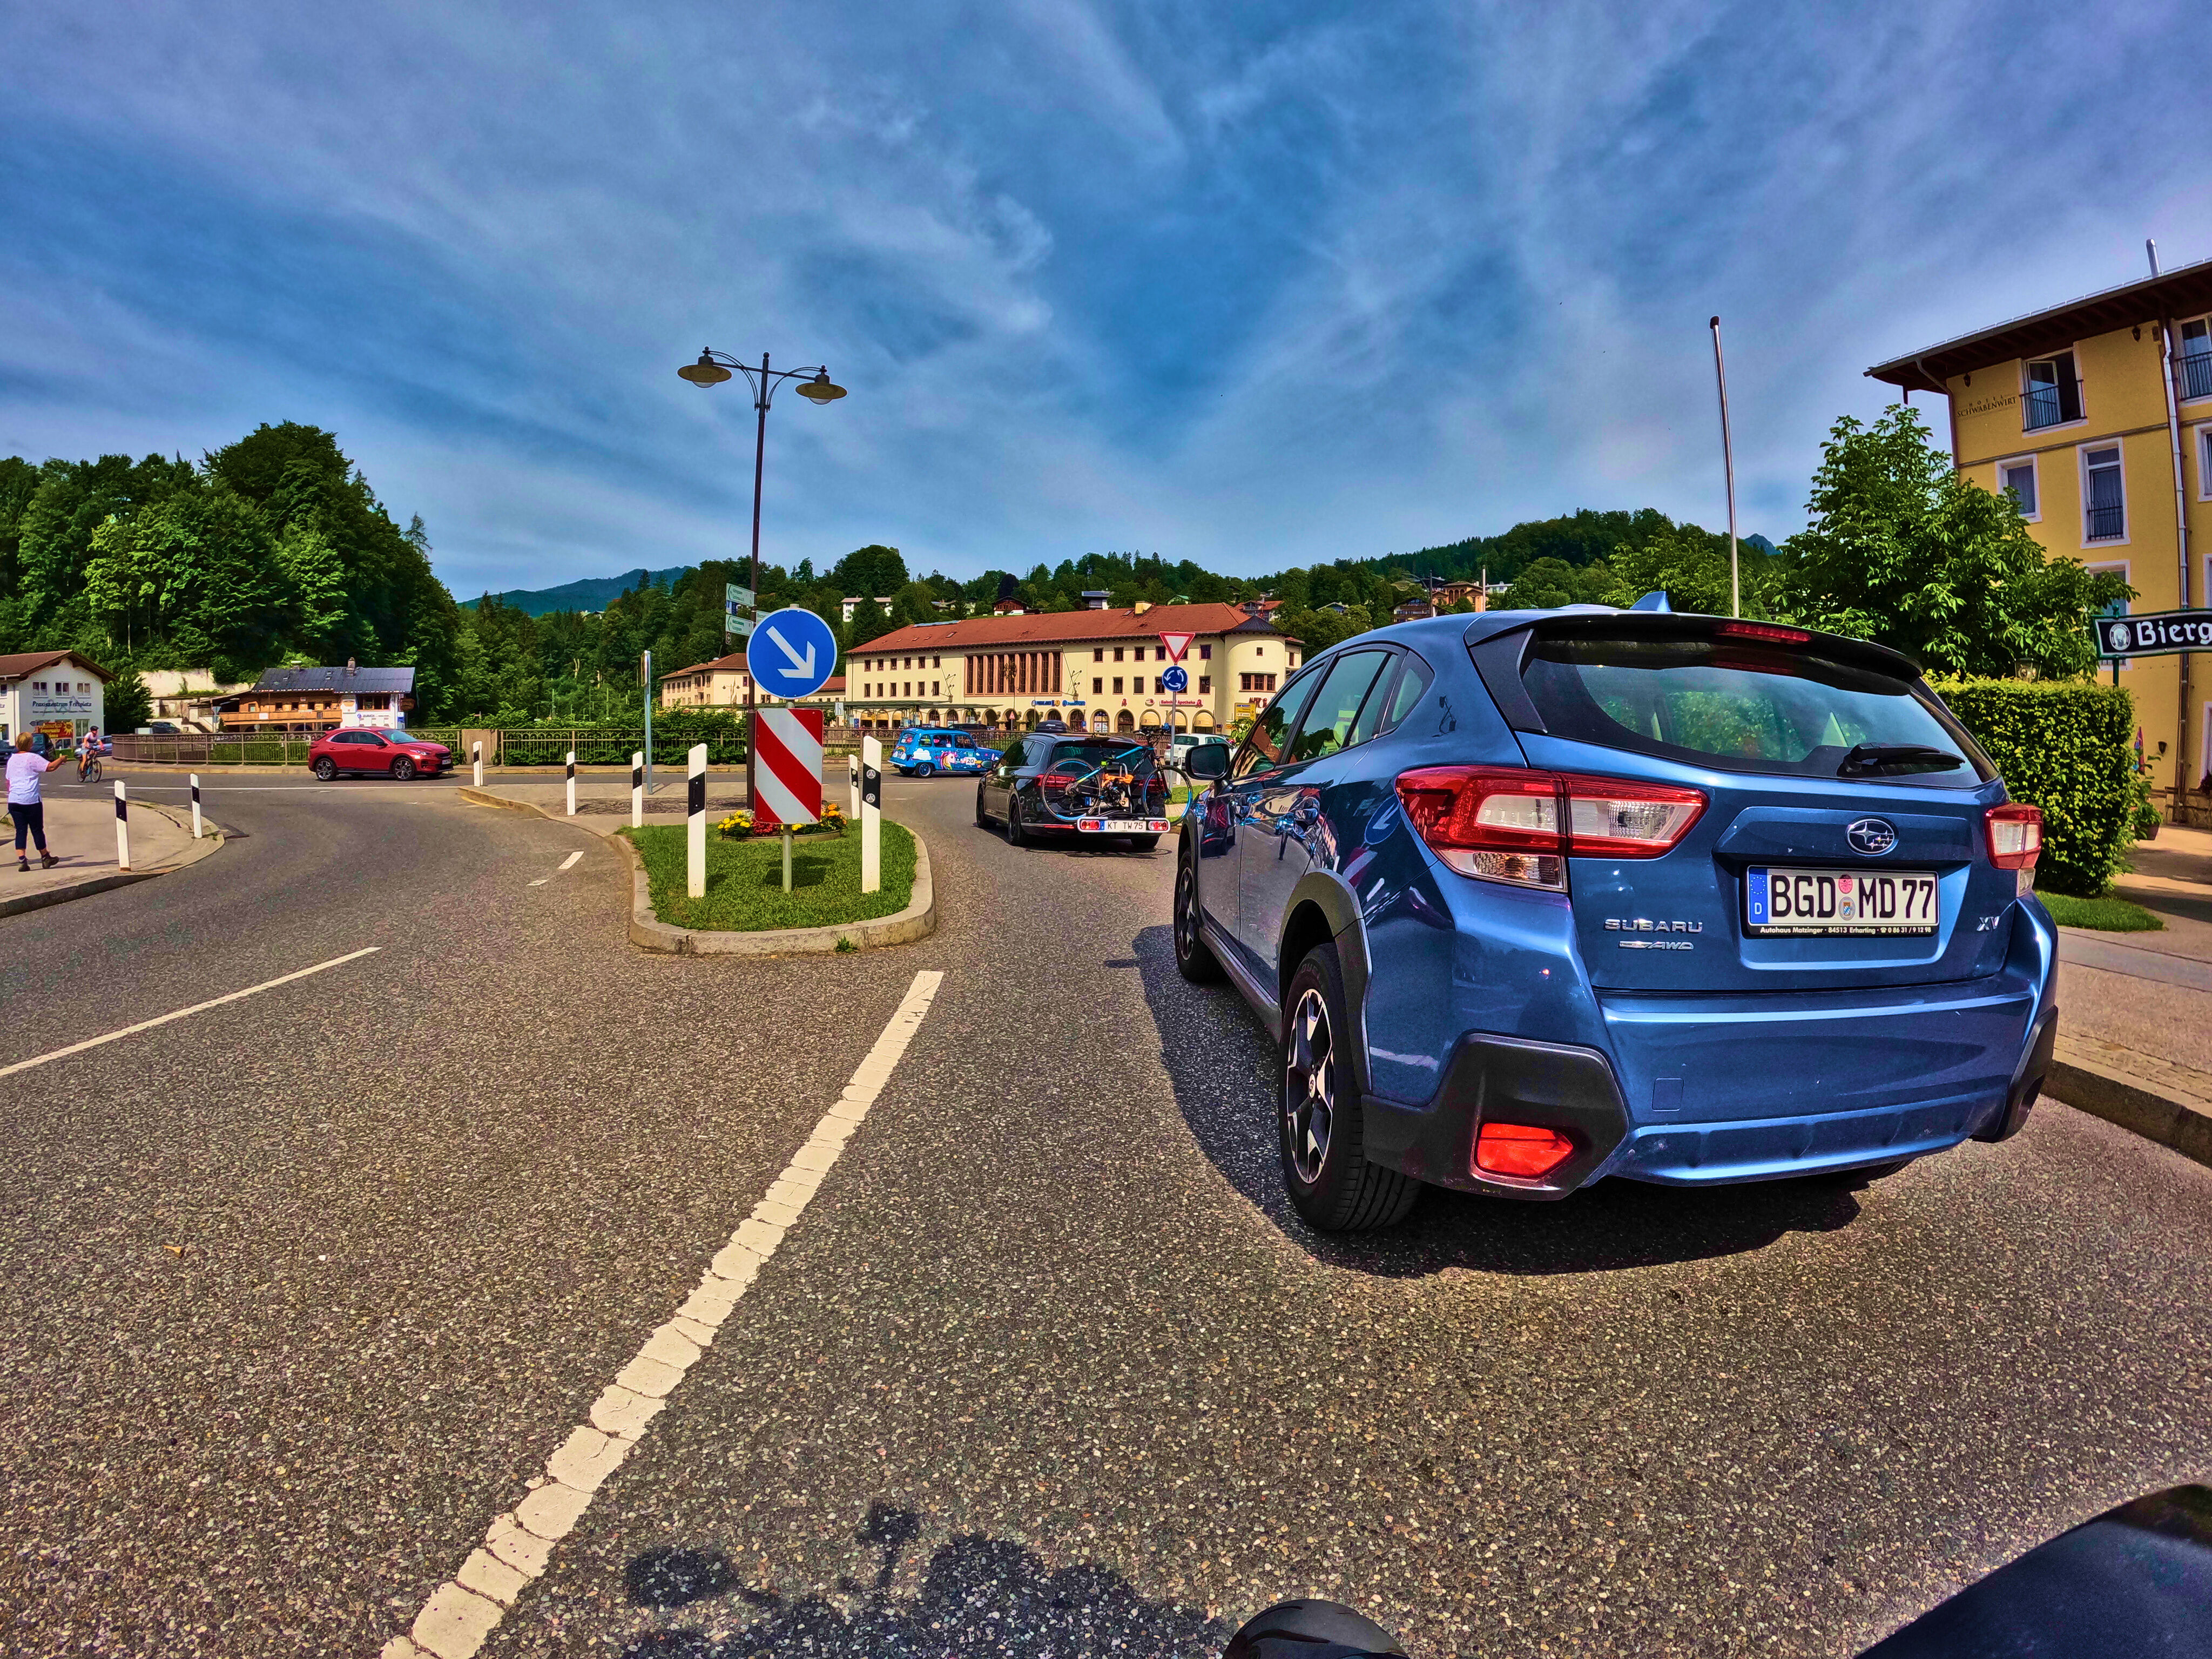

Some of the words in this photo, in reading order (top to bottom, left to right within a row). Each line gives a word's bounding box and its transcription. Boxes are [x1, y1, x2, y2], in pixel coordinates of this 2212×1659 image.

[1957, 396, 2016, 417] SCHWABENWIRT
[1754, 902, 1762, 915] D
[1771, 874, 1836, 918] BGD
[1859, 876, 1896, 919] MD
[1902, 879, 1934, 919] 77
[1604, 919, 1703, 933] SUBARU
[1977, 916, 2000, 932] XV
[1648, 941, 1694, 950] AWD
